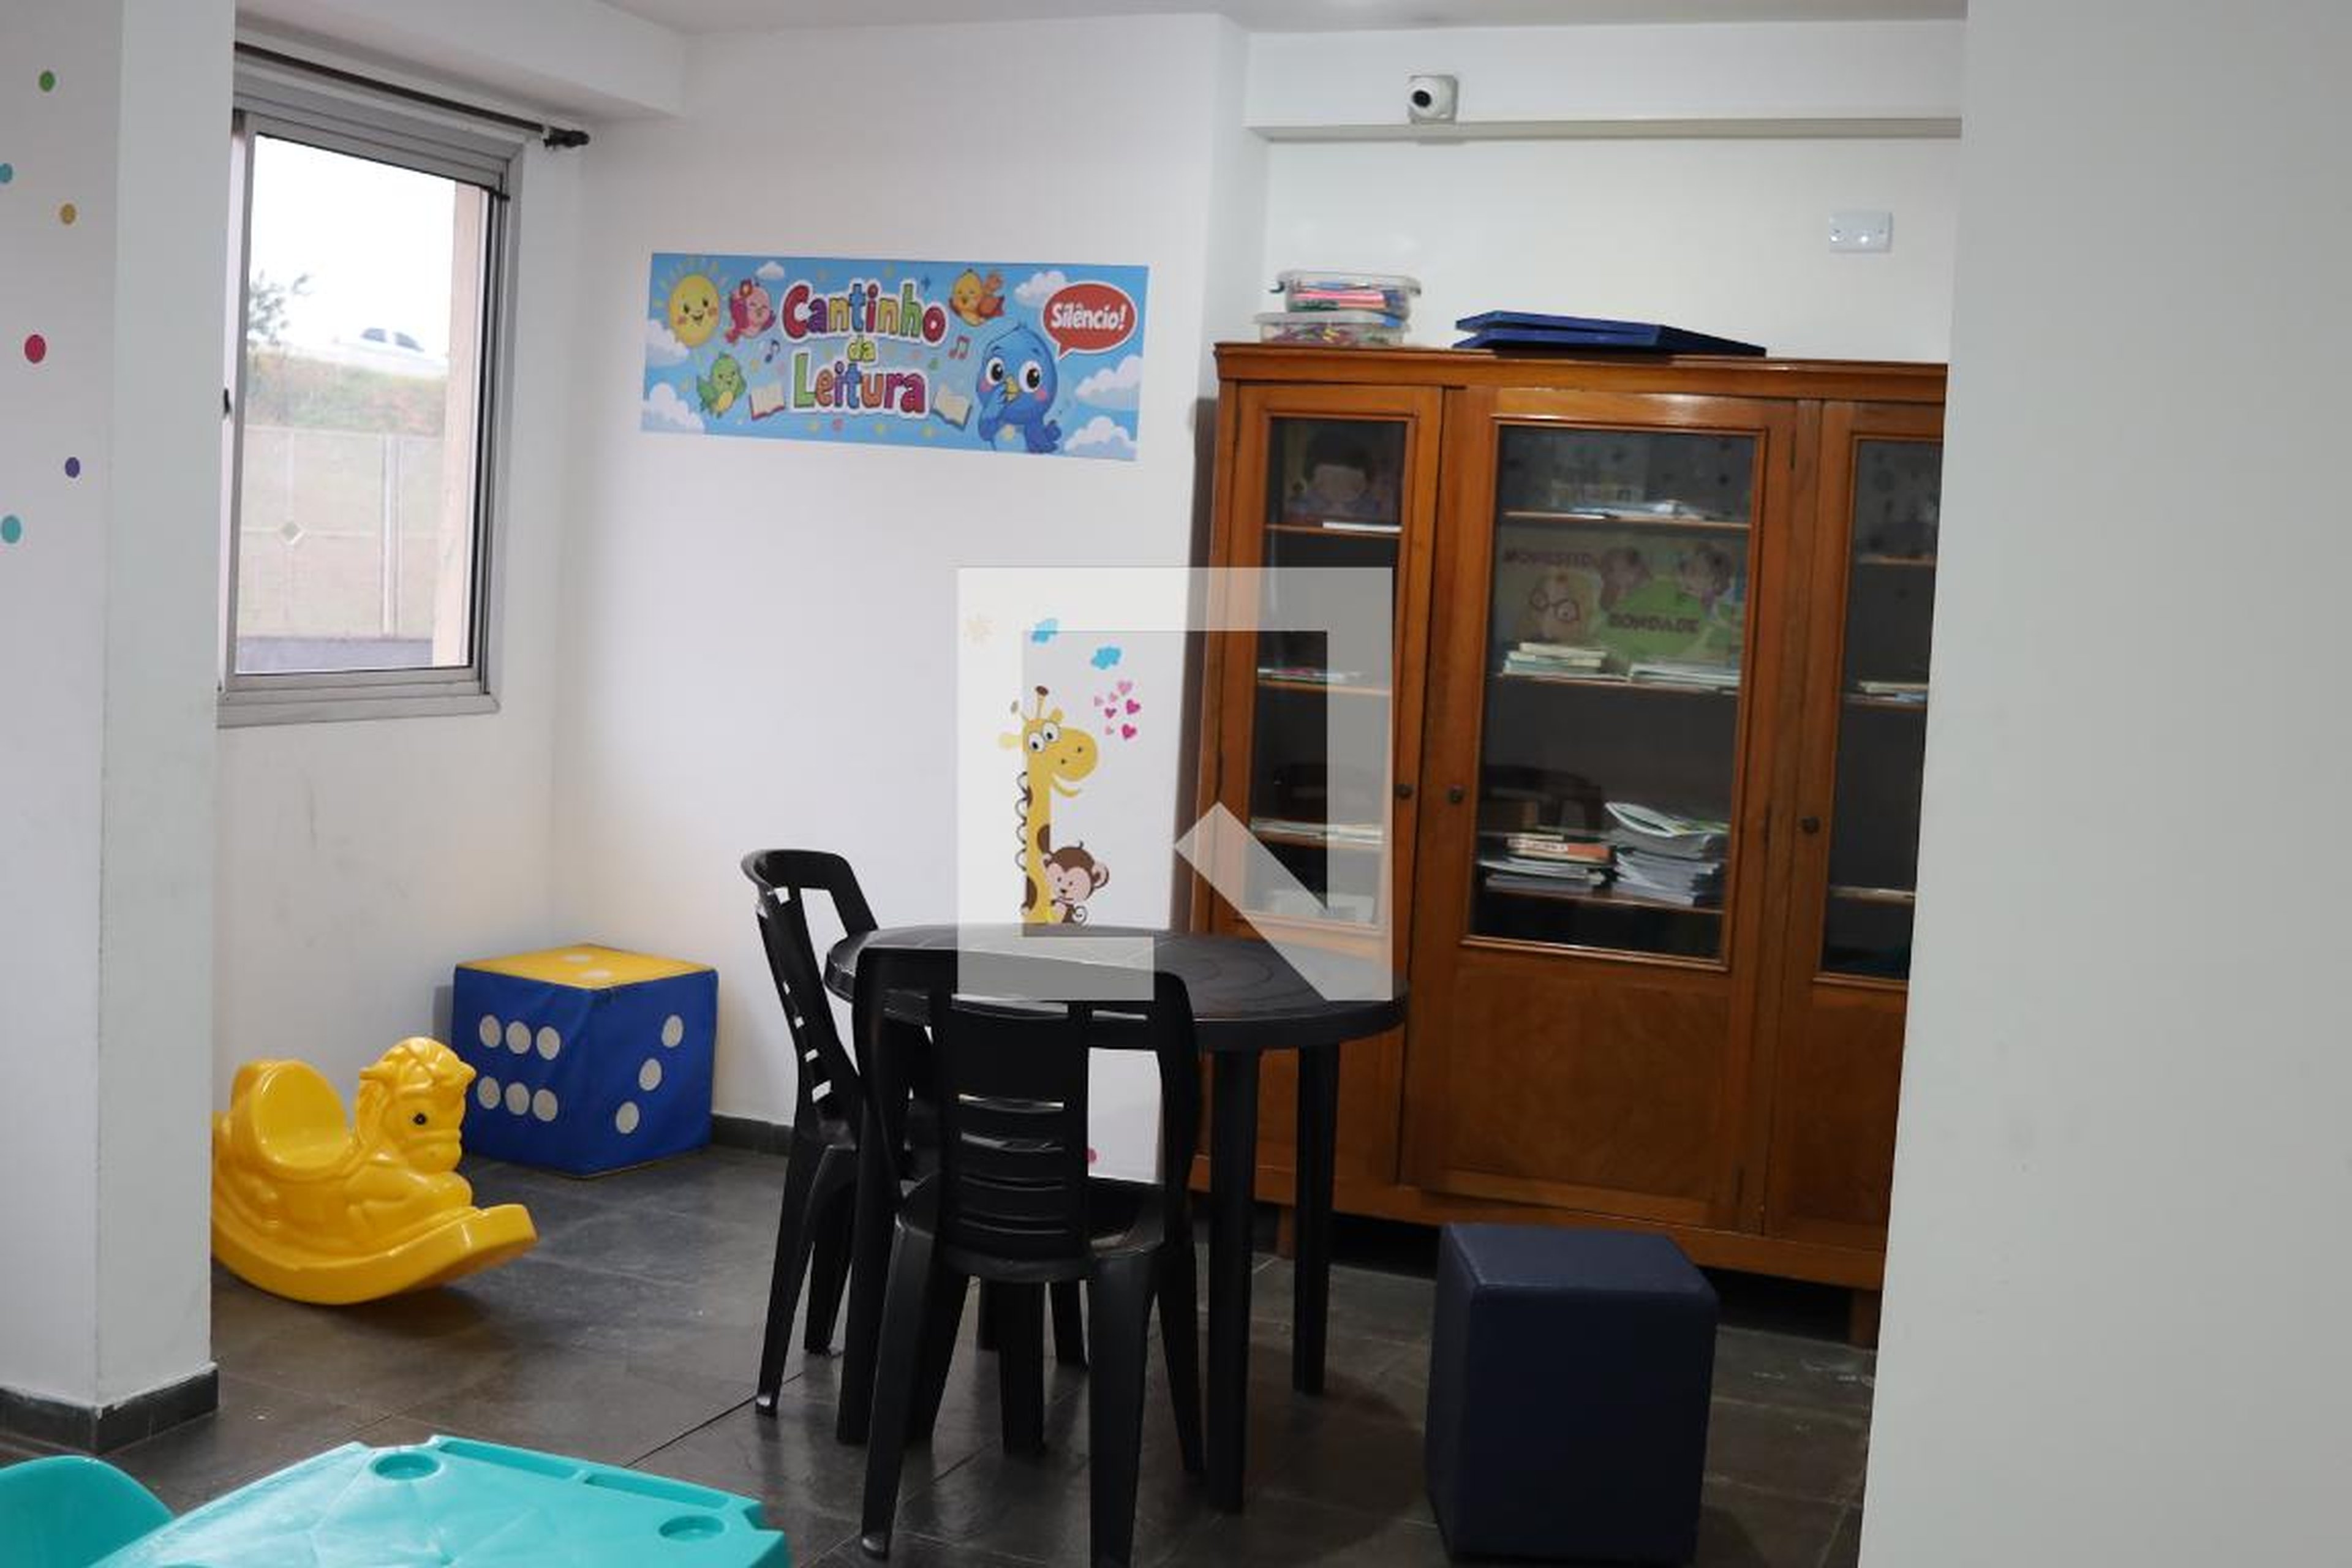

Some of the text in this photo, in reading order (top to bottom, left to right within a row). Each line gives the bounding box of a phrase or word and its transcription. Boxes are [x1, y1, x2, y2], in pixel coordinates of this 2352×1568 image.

[782, 283, 946, 342] Cantinho
[1050, 302, 1128, 331] Silêncio!
[847, 335, 876, 362] da
[794, 353, 925, 413] Leitura
